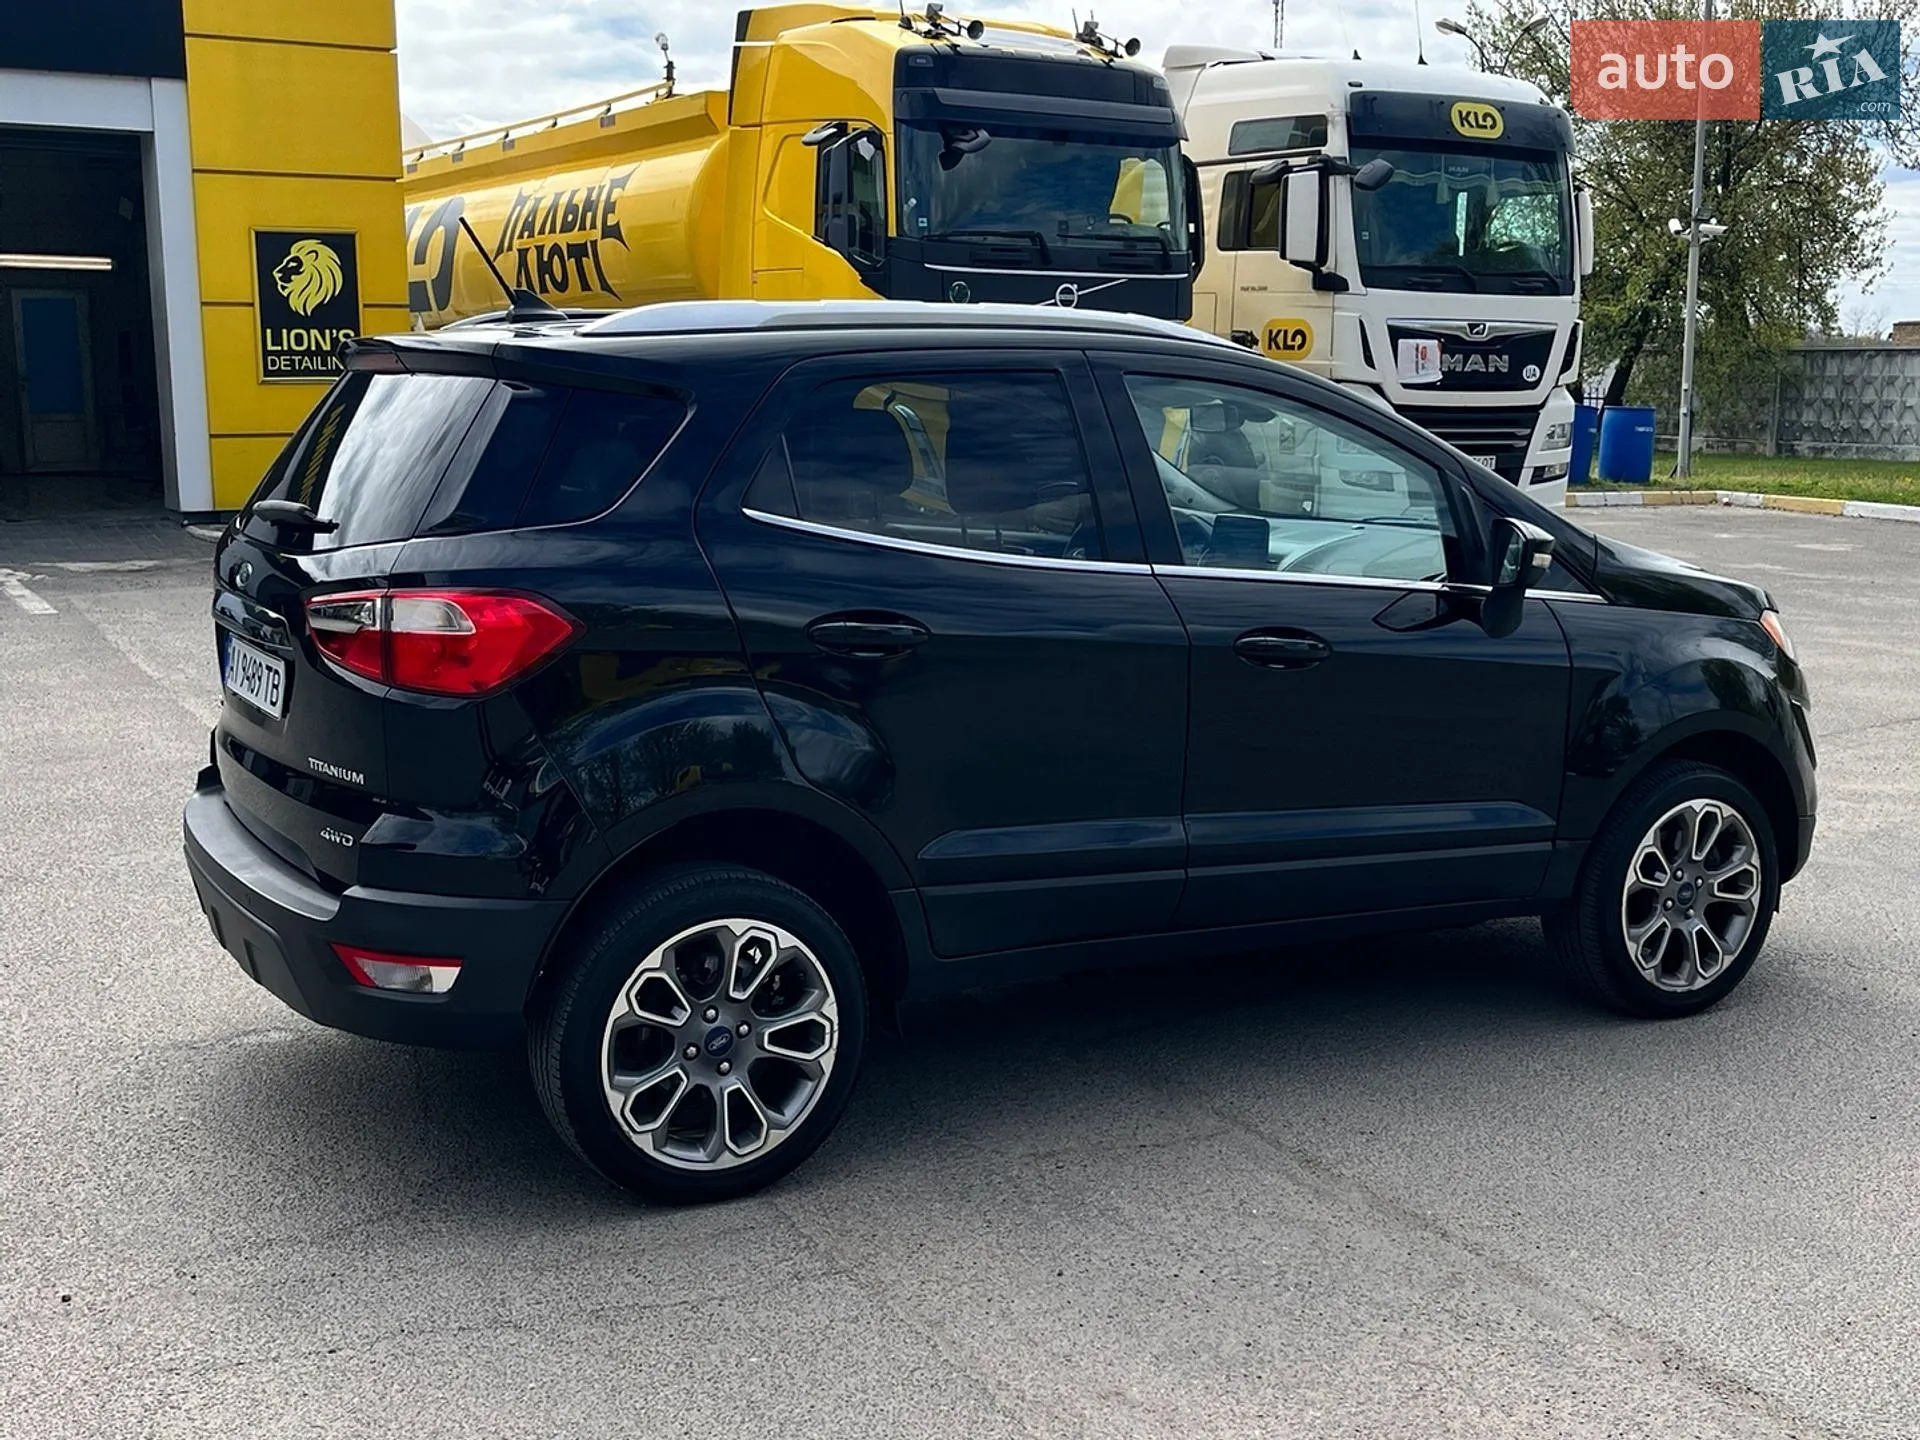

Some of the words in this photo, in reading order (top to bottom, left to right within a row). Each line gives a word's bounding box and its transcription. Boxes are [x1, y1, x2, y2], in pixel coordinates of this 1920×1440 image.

[1457, 109, 1498, 130] KLO
[493, 164, 640, 262] ПАЛЬНЕ
[515, 239, 622, 302] ЛЮТІ
[1267, 328, 1307, 351] KLO
[267, 355, 345, 371] DETAILIN
[1441, 353, 1509, 373] MAN
[1525, 366, 1538, 379] UA
[264, 664, 281, 707] TB
[307, 757, 365, 785] TITANIUM
[320, 827, 354, 847] 4WD
